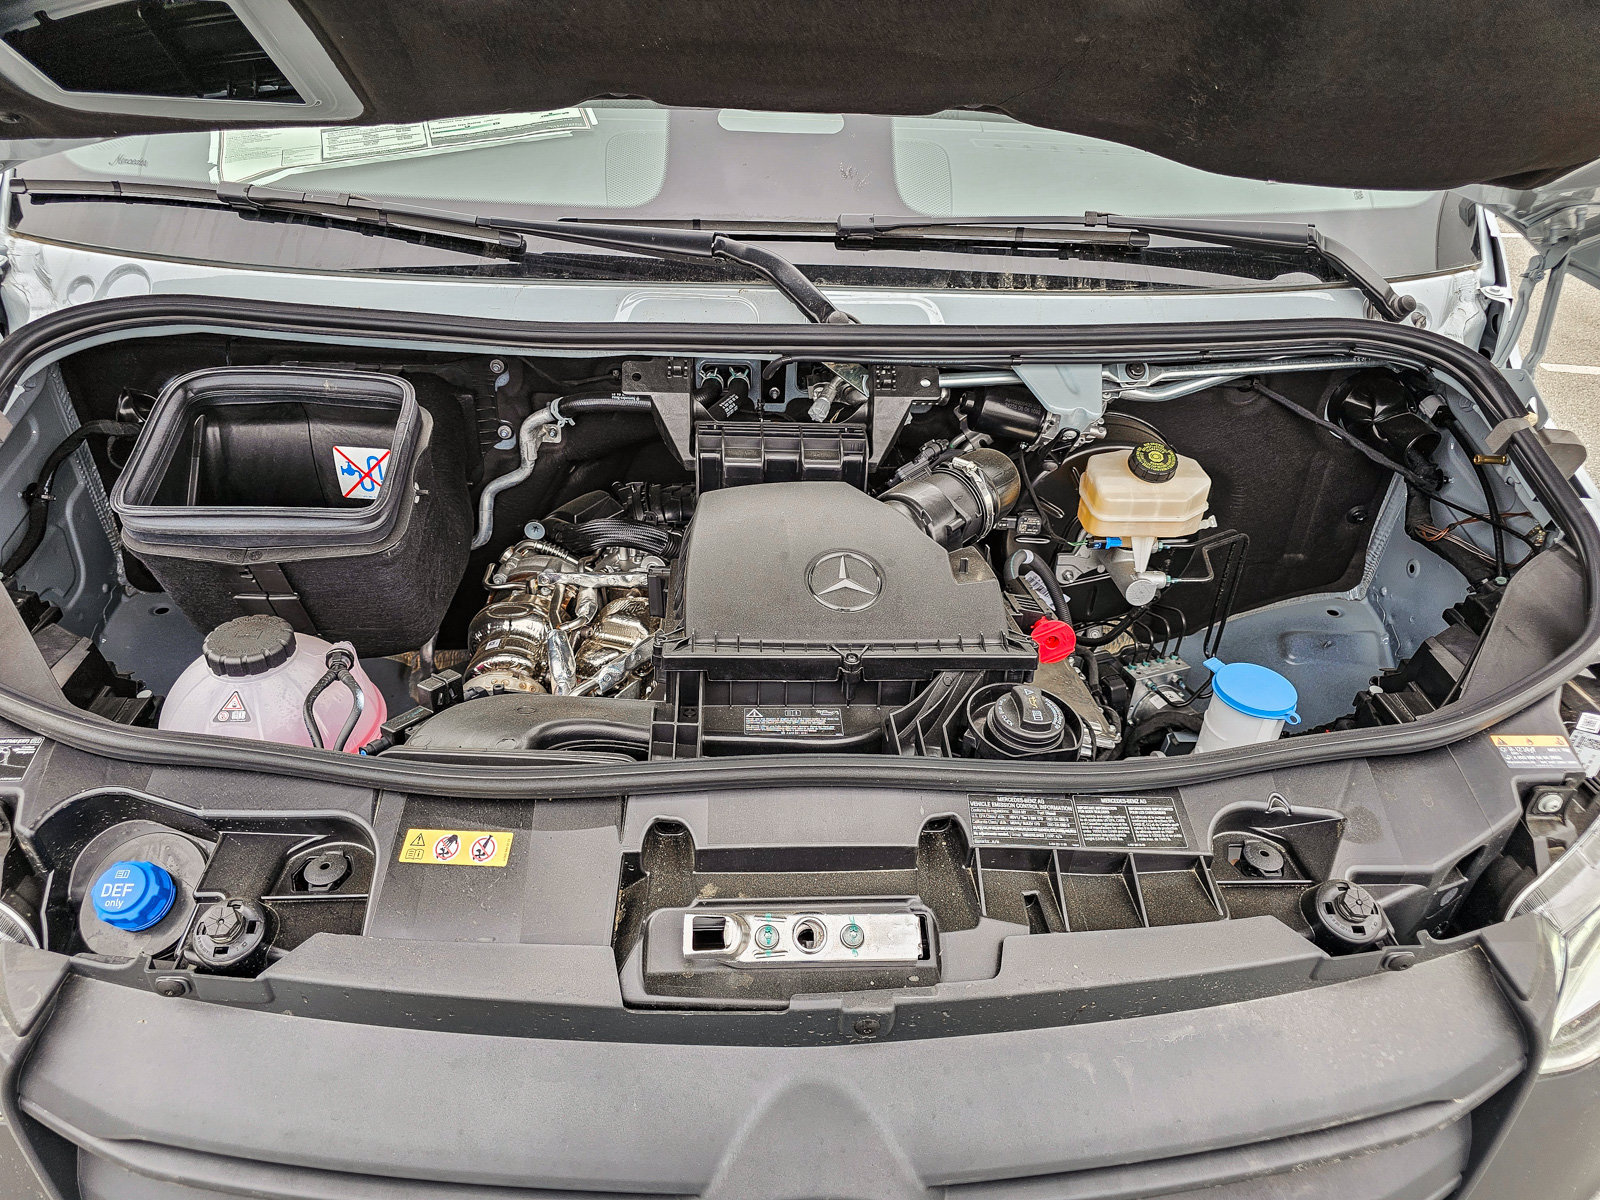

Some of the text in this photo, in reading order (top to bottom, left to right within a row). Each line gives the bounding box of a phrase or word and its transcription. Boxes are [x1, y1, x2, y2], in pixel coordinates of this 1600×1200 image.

[970, 800, 991, 808] VEHICLE
[992, 801, 1015, 809] EMISSION
[1039, 804, 1073, 812] INFORMATION
[101, 883, 134, 896] DEF
[105, 898, 123, 909] only
